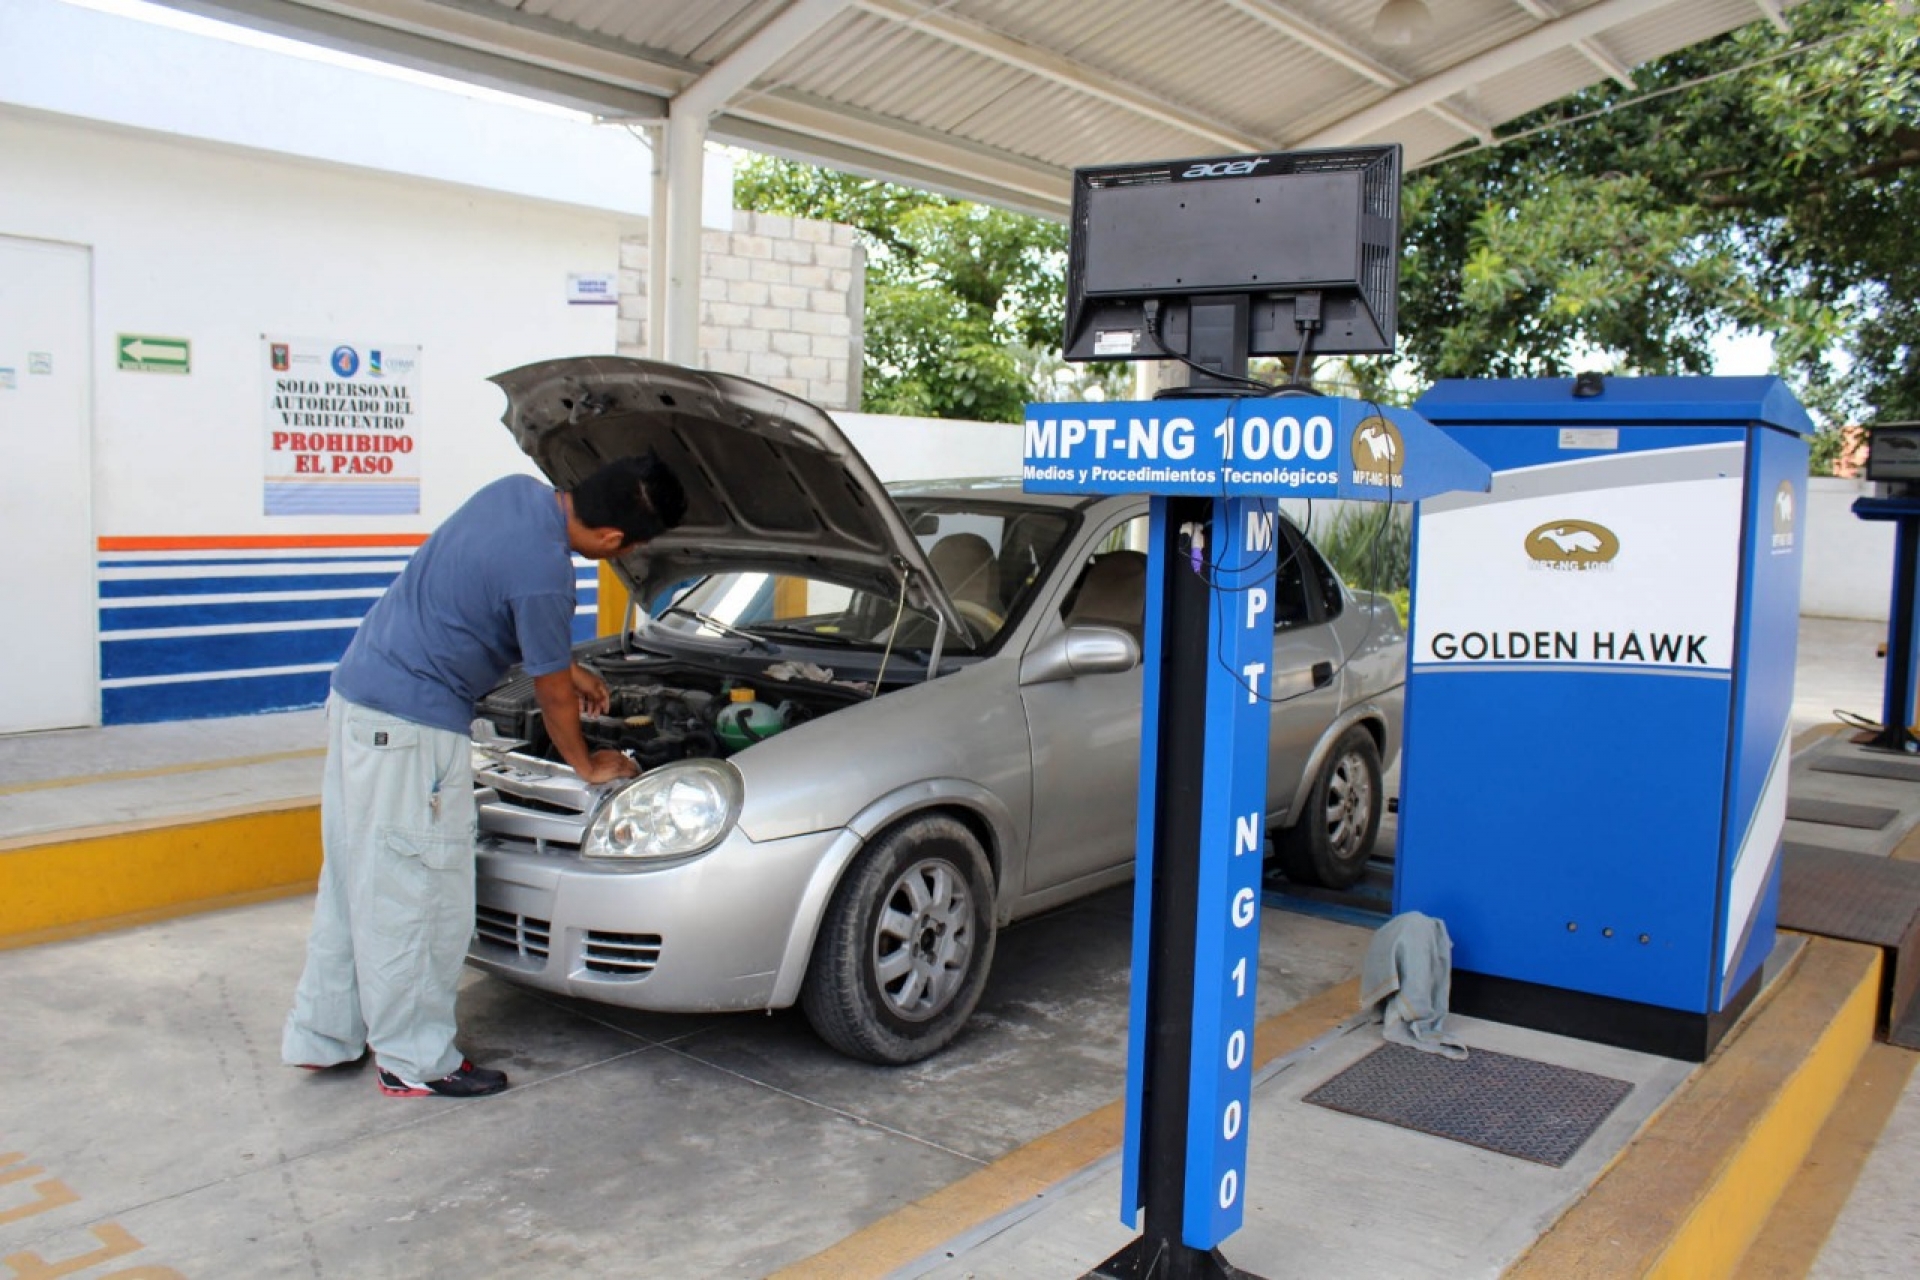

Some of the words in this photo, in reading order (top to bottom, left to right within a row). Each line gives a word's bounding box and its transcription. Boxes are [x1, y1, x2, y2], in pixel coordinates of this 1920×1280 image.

[1182, 157, 1270, 178] acer
[275, 379, 320, 395] SOLO
[324, 382, 411, 399] PERSONAL
[272, 395, 379, 412] AUTORIZADO
[384, 401, 414, 415] DEL
[281, 412, 405, 429] VERIFICENTRO
[271, 431, 413, 453] PROHIBIDO
[1024, 418, 1195, 459] MPT-NG
[1214, 416, 1333, 460] 1000
[295, 454, 325, 474] EL
[331, 455, 394, 474] PASO
[1023, 465, 1075, 481] Medios
[1078, 469, 1088, 484] y
[1091, 466, 1216, 483] Procedimientos
[1221, 468, 1339, 487] Tecnológicos
[1431, 632, 1577, 660] GOLDEN
[1593, 631, 1708, 664] HAWK
